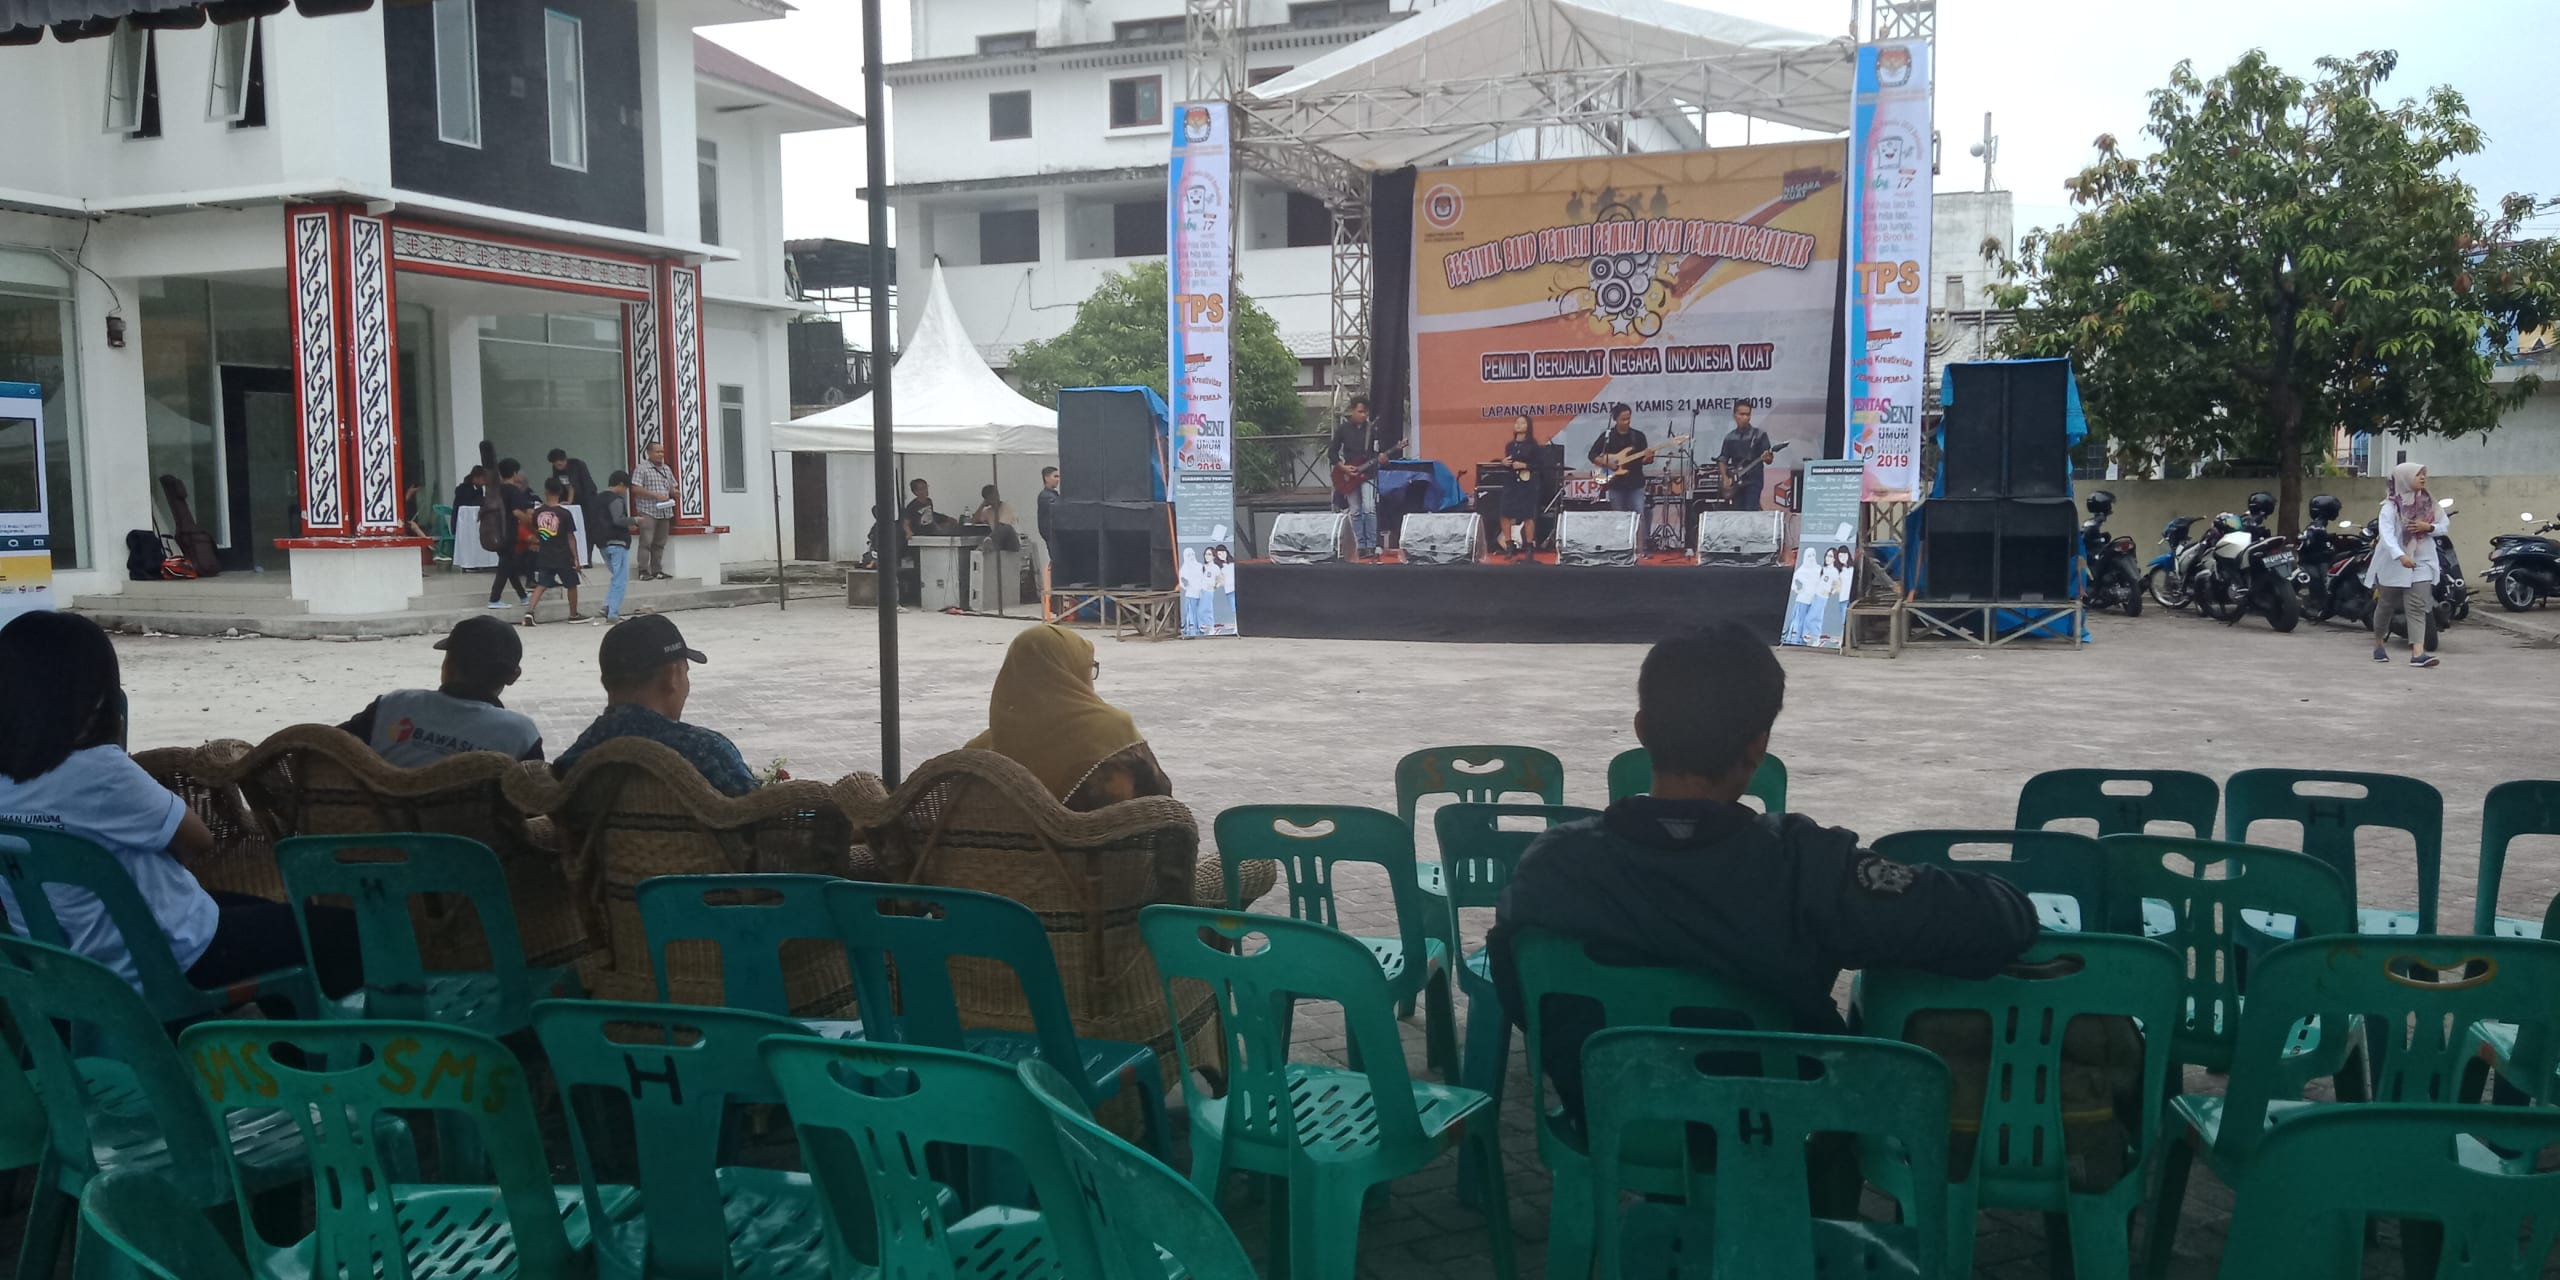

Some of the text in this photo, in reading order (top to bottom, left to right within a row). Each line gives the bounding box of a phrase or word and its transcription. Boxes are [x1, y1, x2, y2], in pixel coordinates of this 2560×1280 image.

[1443, 216, 1816, 289] FESTIVAL BAND PEMILIH PEMULA KOTA PEMATANGSIANTAR
[1854, 260, 1920, 295] TPS
[1174, 293, 1224, 324] TPS
[1482, 344, 1774, 380] PEMILIH BERDAULAT NEGARA INDONESIA KUAT
[1482, 405, 1545, 418] LAPANGAN
[1550, 402, 1621, 415] PARIWISAT
[1636, 400, 1673, 412] KAMIS
[1678, 400, 1690, 411] 21
[1697, 398, 1739, 410] MARET
[1878, 432, 1908, 440] UMUM
[1877, 455, 1908, 468] 2019
[25, 814, 61, 824] UMUM
[625, 1053, 683, 1106] H
[1739, 1108, 1774, 1146] H
